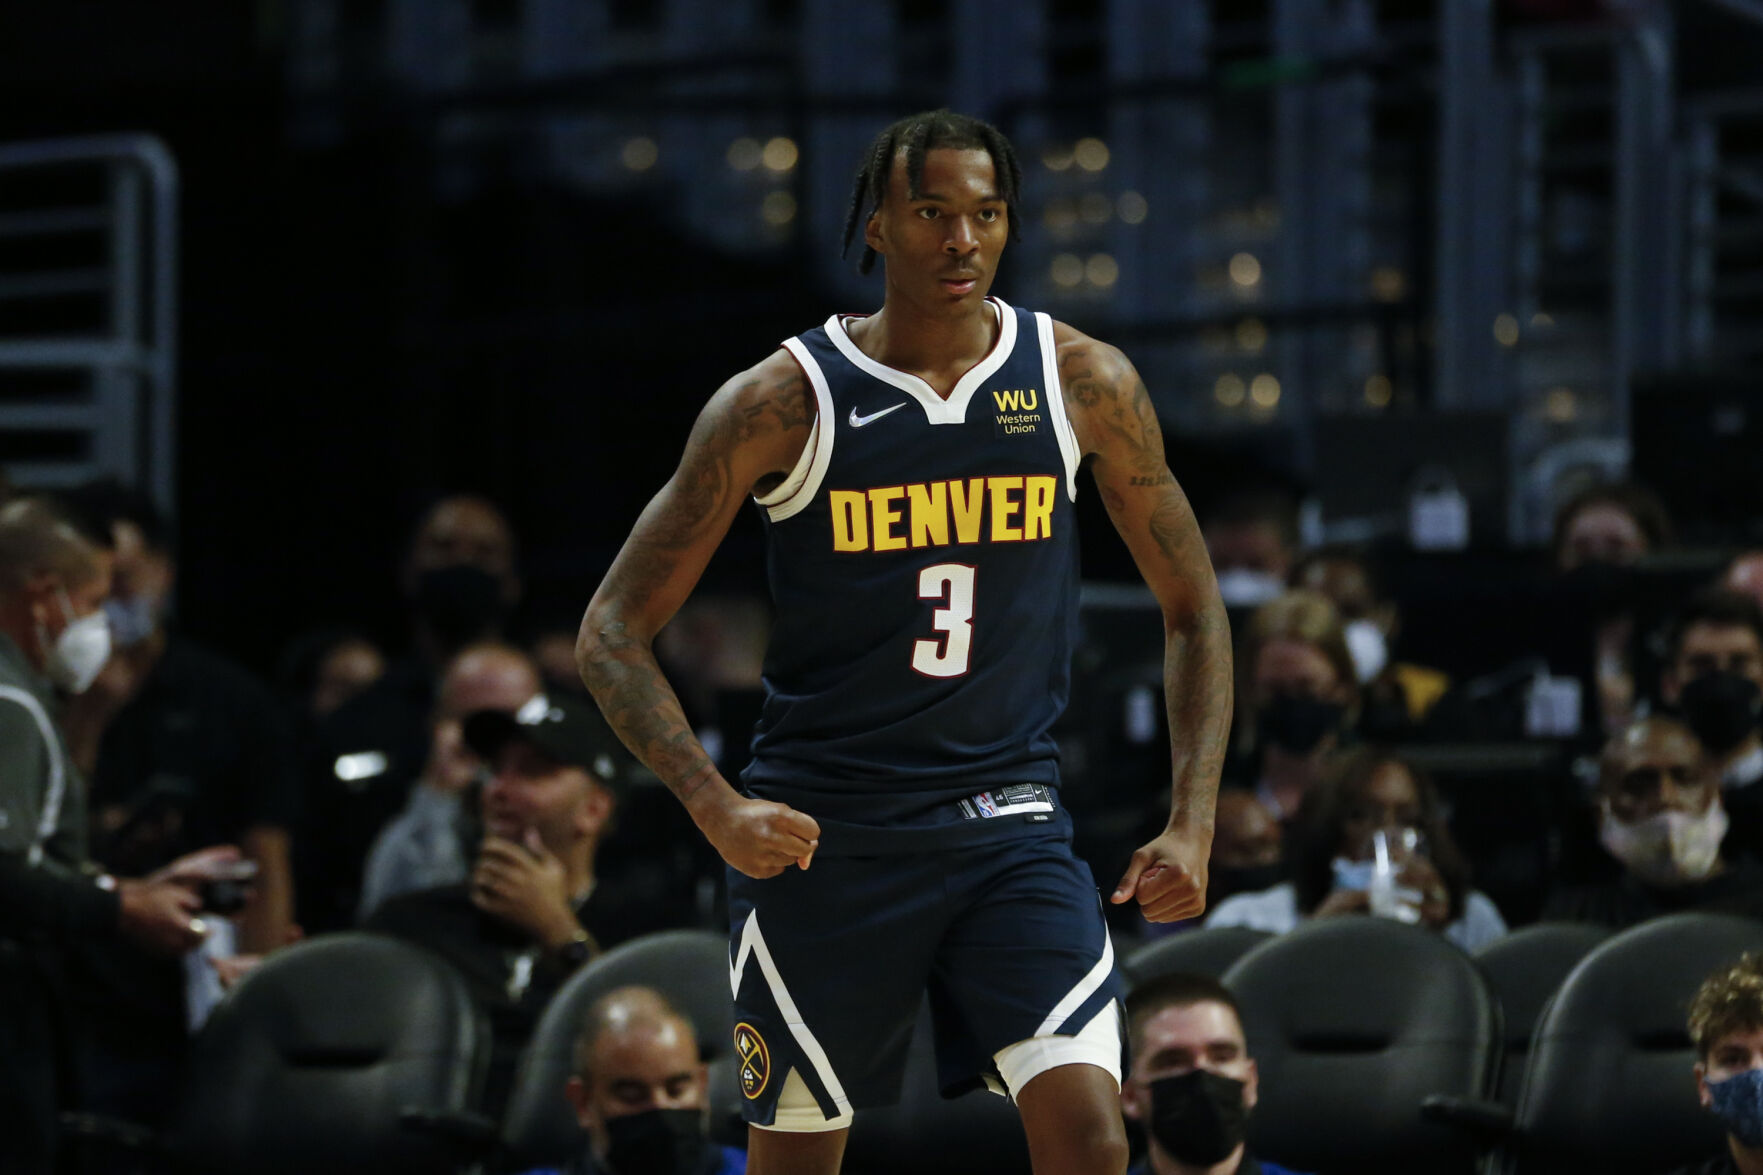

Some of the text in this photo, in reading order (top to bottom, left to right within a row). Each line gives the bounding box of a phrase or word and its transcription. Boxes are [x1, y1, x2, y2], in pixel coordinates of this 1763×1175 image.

[993, 390, 1038, 412] WU
[996, 412, 1041, 425] Western
[1005, 422, 1036, 435] Union
[829, 474, 1057, 552] DENVER
[909, 561, 978, 679] 3
